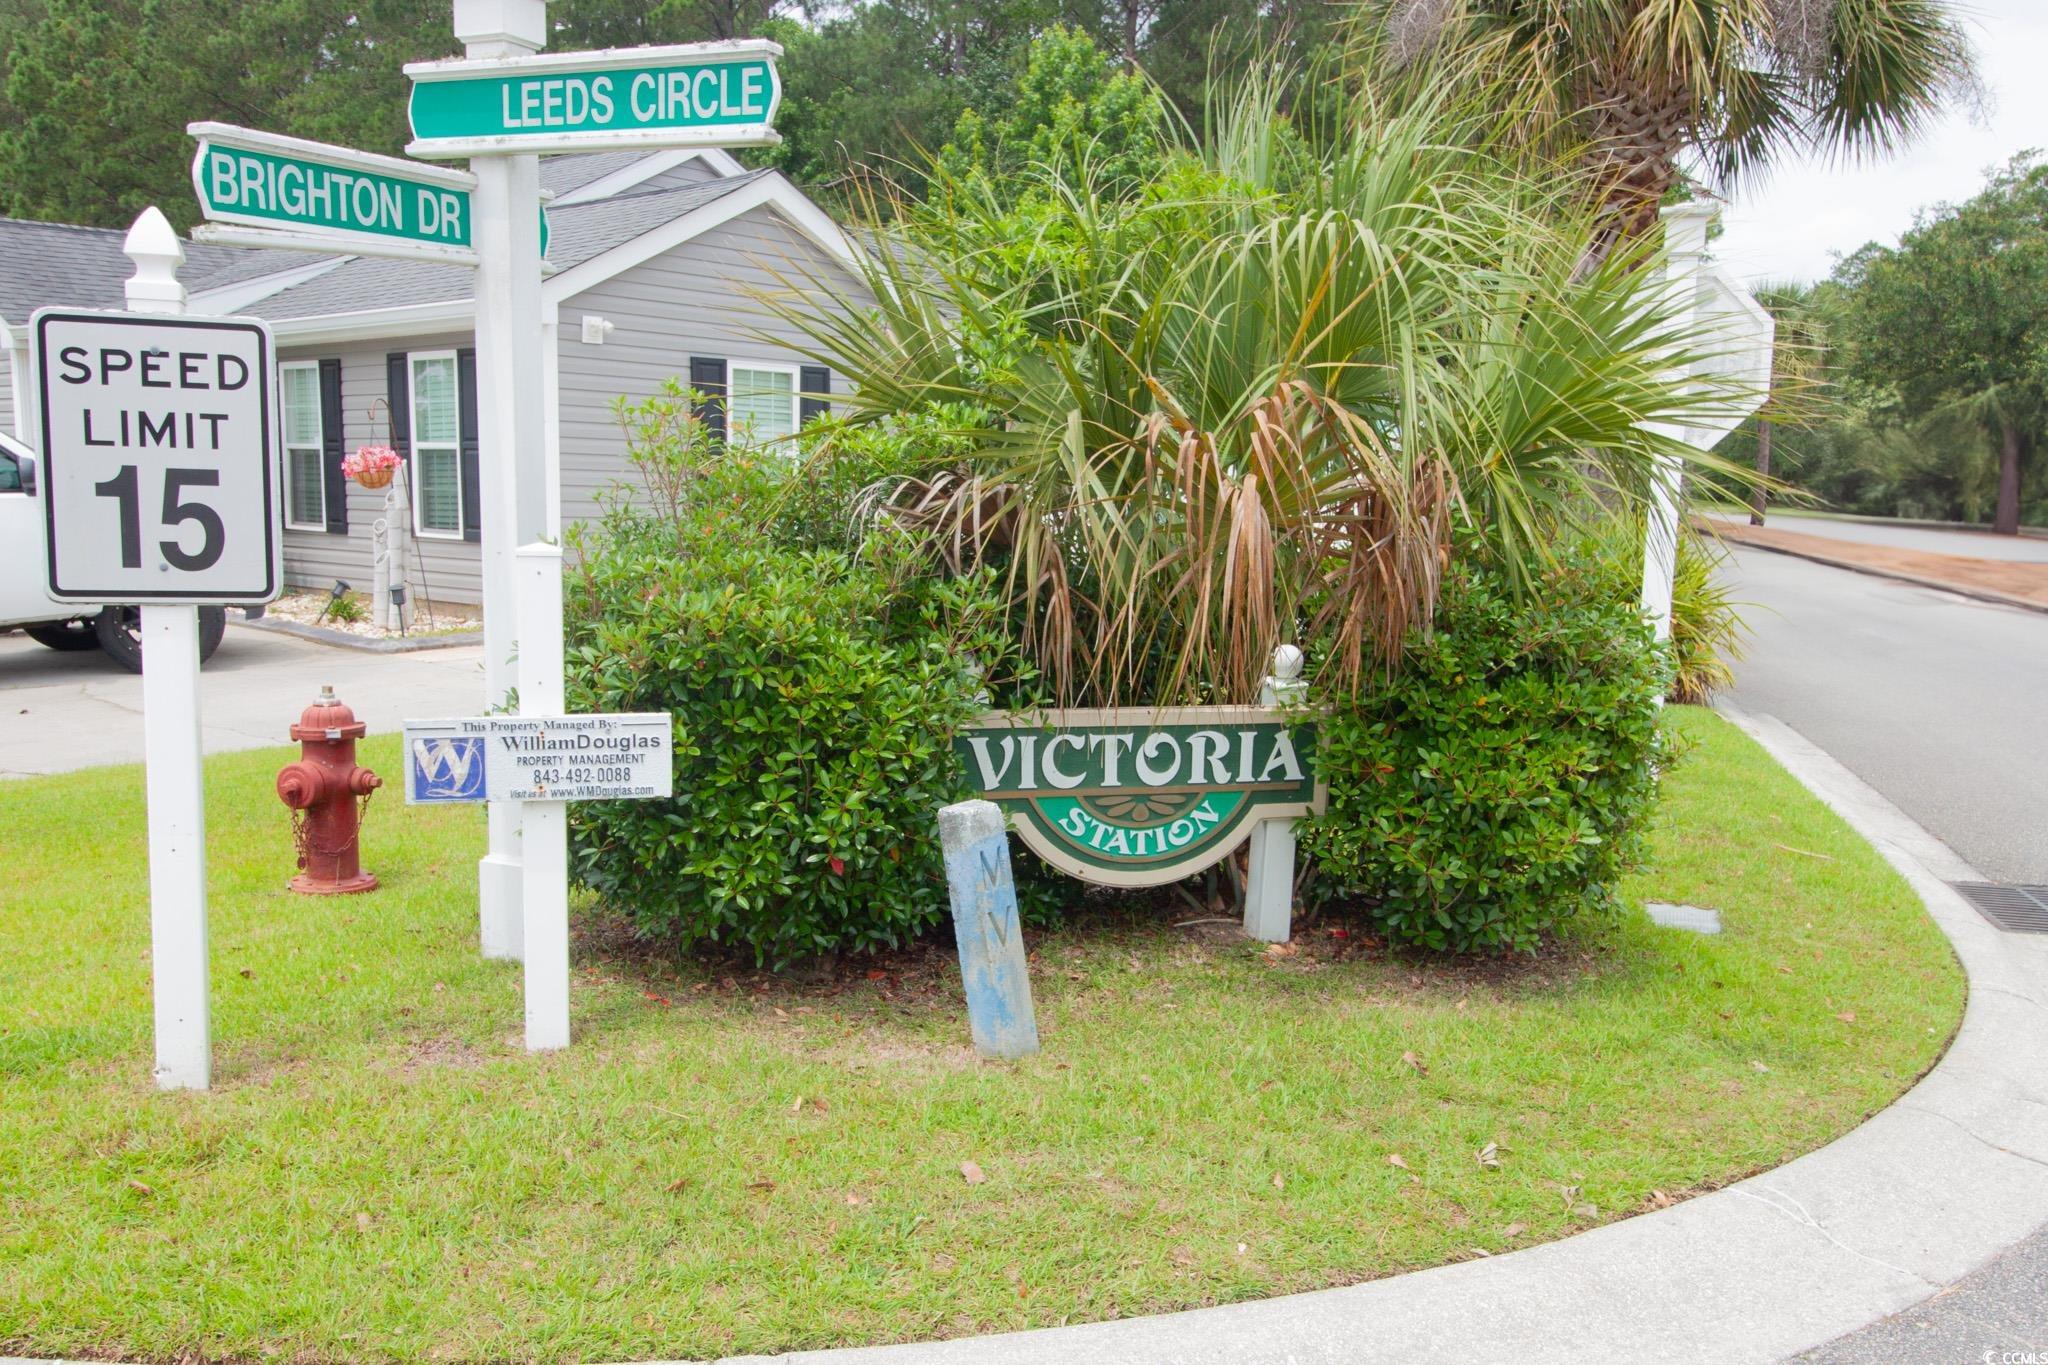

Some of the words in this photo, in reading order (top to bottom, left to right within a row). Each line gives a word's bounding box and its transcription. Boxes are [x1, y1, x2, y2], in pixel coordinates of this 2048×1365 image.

[502, 75, 614, 128] LEEDS
[630, 66, 764, 122] CIRCLE
[211, 151, 402, 231] BRIGHTON
[417, 190, 462, 240] DR
[59, 346, 249, 391] SPEED
[83, 408, 229, 449] LIMIT
[95, 465, 225, 571] 15
[462, 722, 487, 732] This
[490, 720, 540, 733] Property
[543, 720, 595, 731] Managed
[599, 719, 618, 731] By:
[501, 734, 662, 752] WilliamDouglas
[517, 755, 564, 766] PROPERTY
[569, 754, 646, 765] MANAGEMENT
[534, 767, 632, 784] 843-492-0088
[967, 729, 1306, 791] VICTORIA
[1058, 800, 1220, 856] STATION
